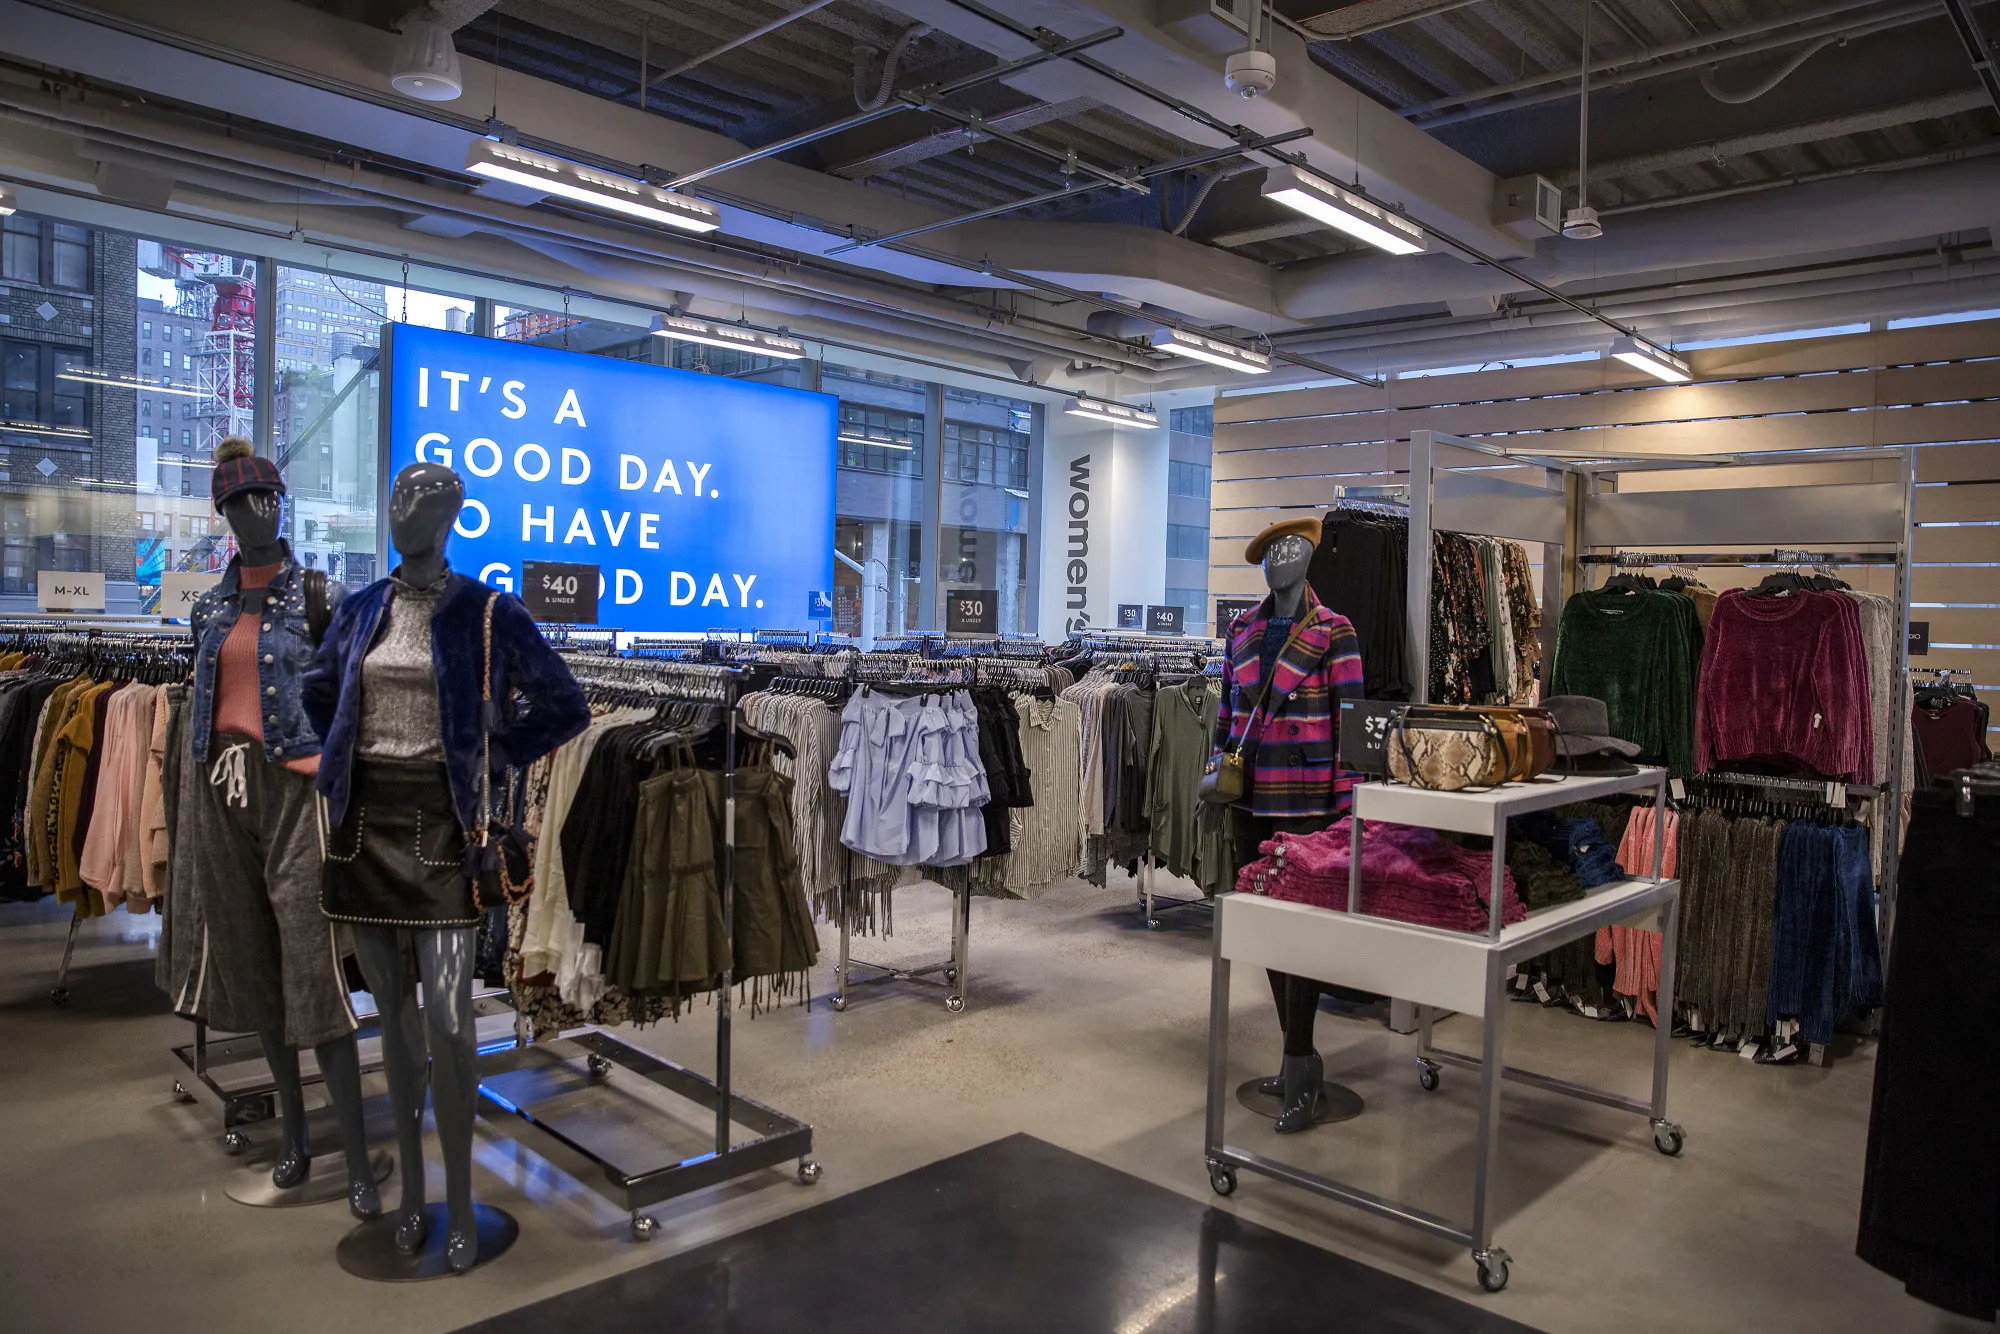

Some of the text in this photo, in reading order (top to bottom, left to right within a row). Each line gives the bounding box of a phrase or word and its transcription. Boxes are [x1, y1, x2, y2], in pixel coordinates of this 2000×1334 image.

[418, 367, 587, 428] IT'S A
[415, 432, 719, 499] GOOD DAY.
[453, 498, 660, 550] O HAVE
[54, 585, 90, 596] M-XL
[478, 562, 765, 609] GD DAY.
[542, 574, 578, 595] $40
[960, 600, 983, 616] $30
[1124, 609, 1136, 617] $30
[1156, 611, 1174, 622] $40
[1364, 715, 1389, 740] $3
